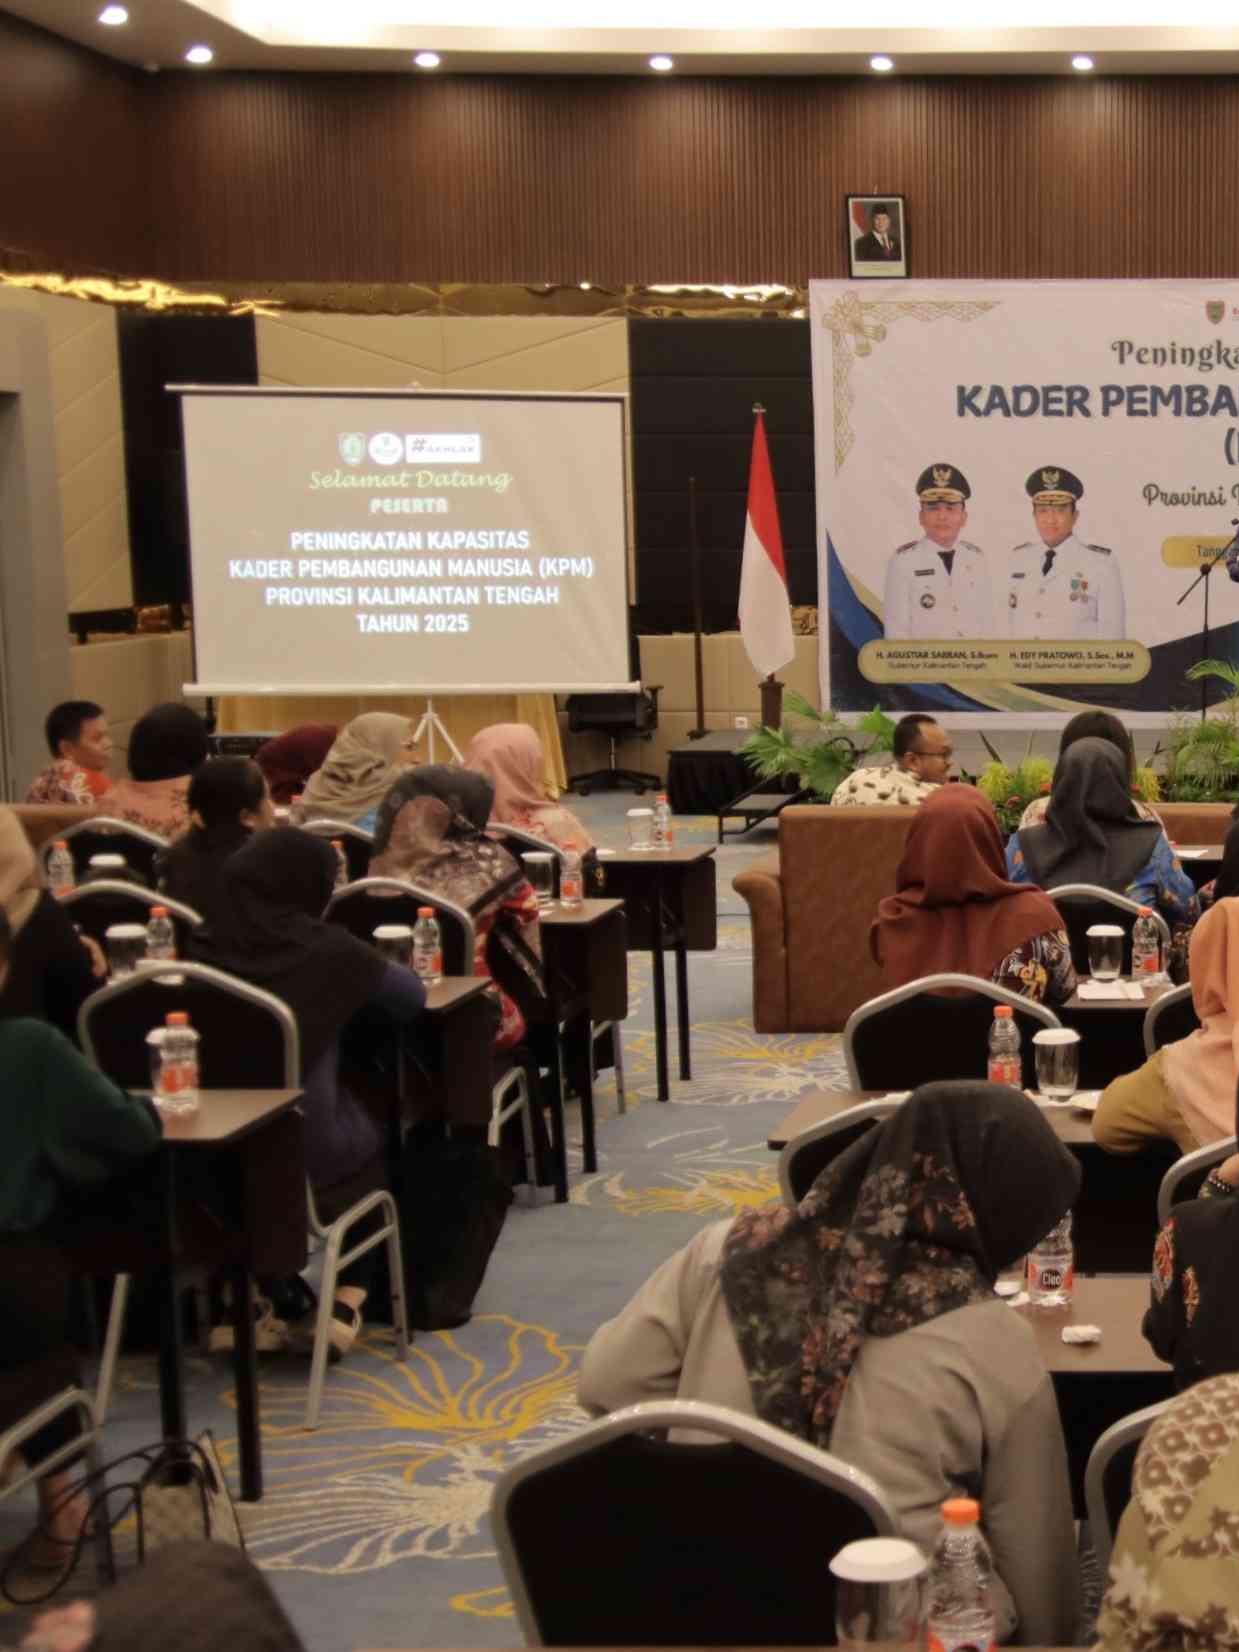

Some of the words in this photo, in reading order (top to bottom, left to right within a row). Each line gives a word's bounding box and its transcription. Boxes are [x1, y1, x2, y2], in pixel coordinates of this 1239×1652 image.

[956, 384, 1091, 418] KADER
[309, 470, 411, 491] Selamat
[415, 470, 513, 493] Datang
[1142, 483, 1226, 507] Provinsi
[290, 531, 422, 550] PENINGKATAN
[427, 531, 530, 549] KAPASITAS
[229, 560, 293, 579] KADER
[299, 559, 441, 578] PEMBANGUNAN
[447, 558, 533, 577] MANUSIA
[538, 557, 594, 580] (KPM)
[265, 587, 353, 606] PROVINSI
[357, 586, 479, 605] KALIMANTAN
[484, 586, 560, 604] TENGAH
[357, 614, 419, 633] TAHUN
[424, 614, 470, 632] 2025
